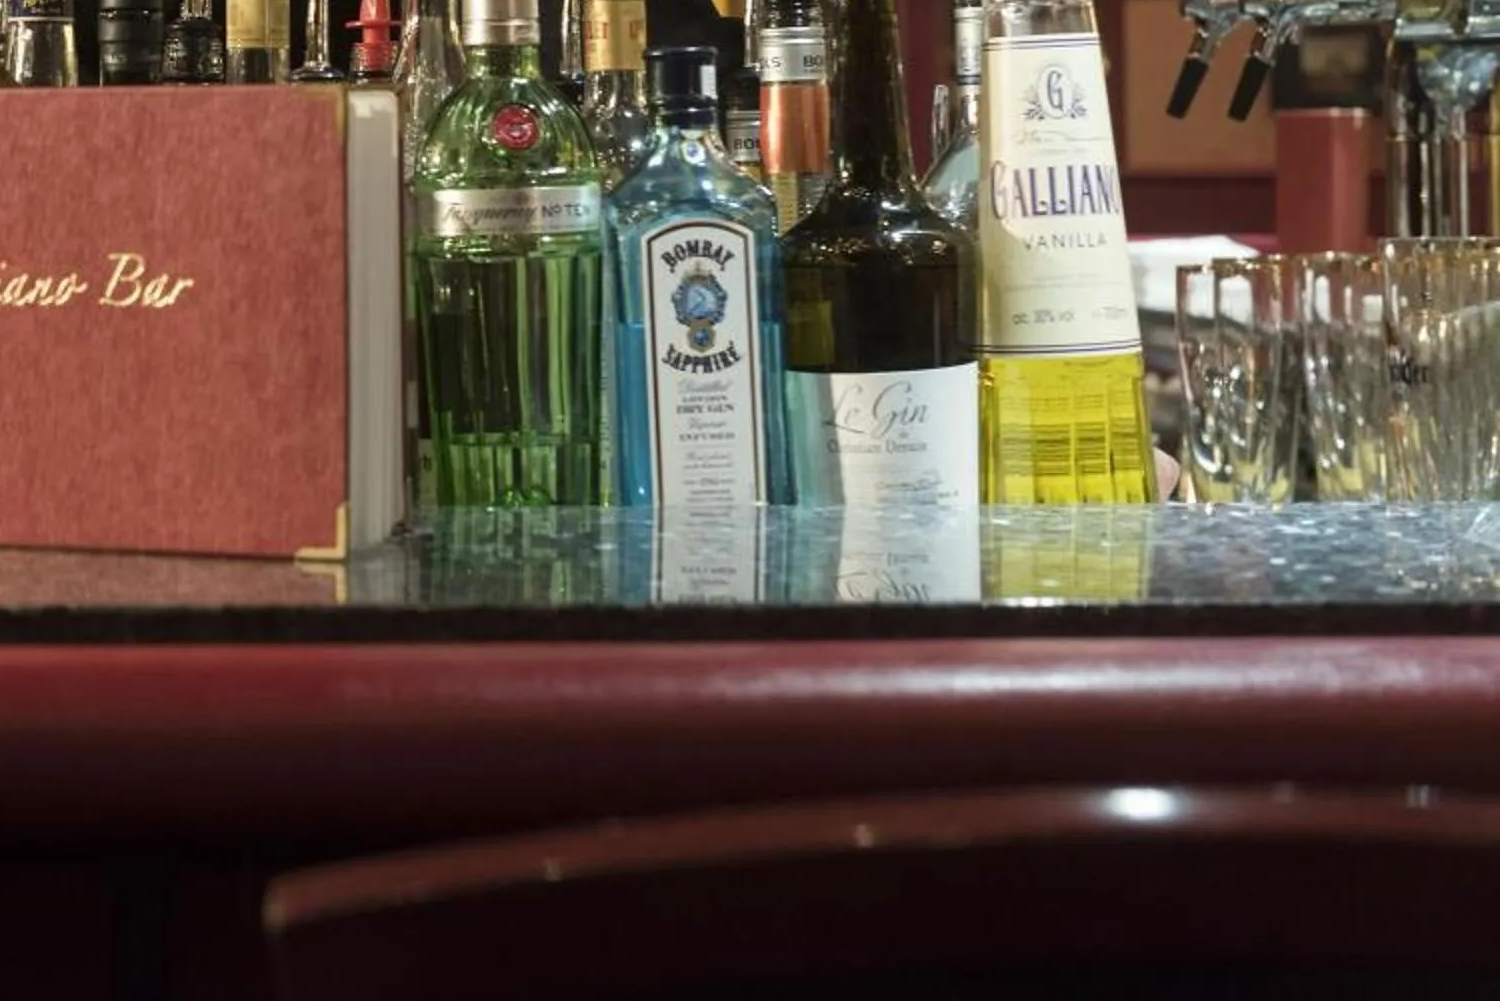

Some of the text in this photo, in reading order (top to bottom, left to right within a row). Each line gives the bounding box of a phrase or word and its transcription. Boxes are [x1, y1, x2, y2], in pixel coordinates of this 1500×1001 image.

[661, 239, 736, 269] BOMBAY
[1022, 231, 1108, 251] VANILLA
[99, 252, 195, 308] Bar
[661, 341, 741, 374] SAPPHIRE
[871, 380, 930, 439] Gin
